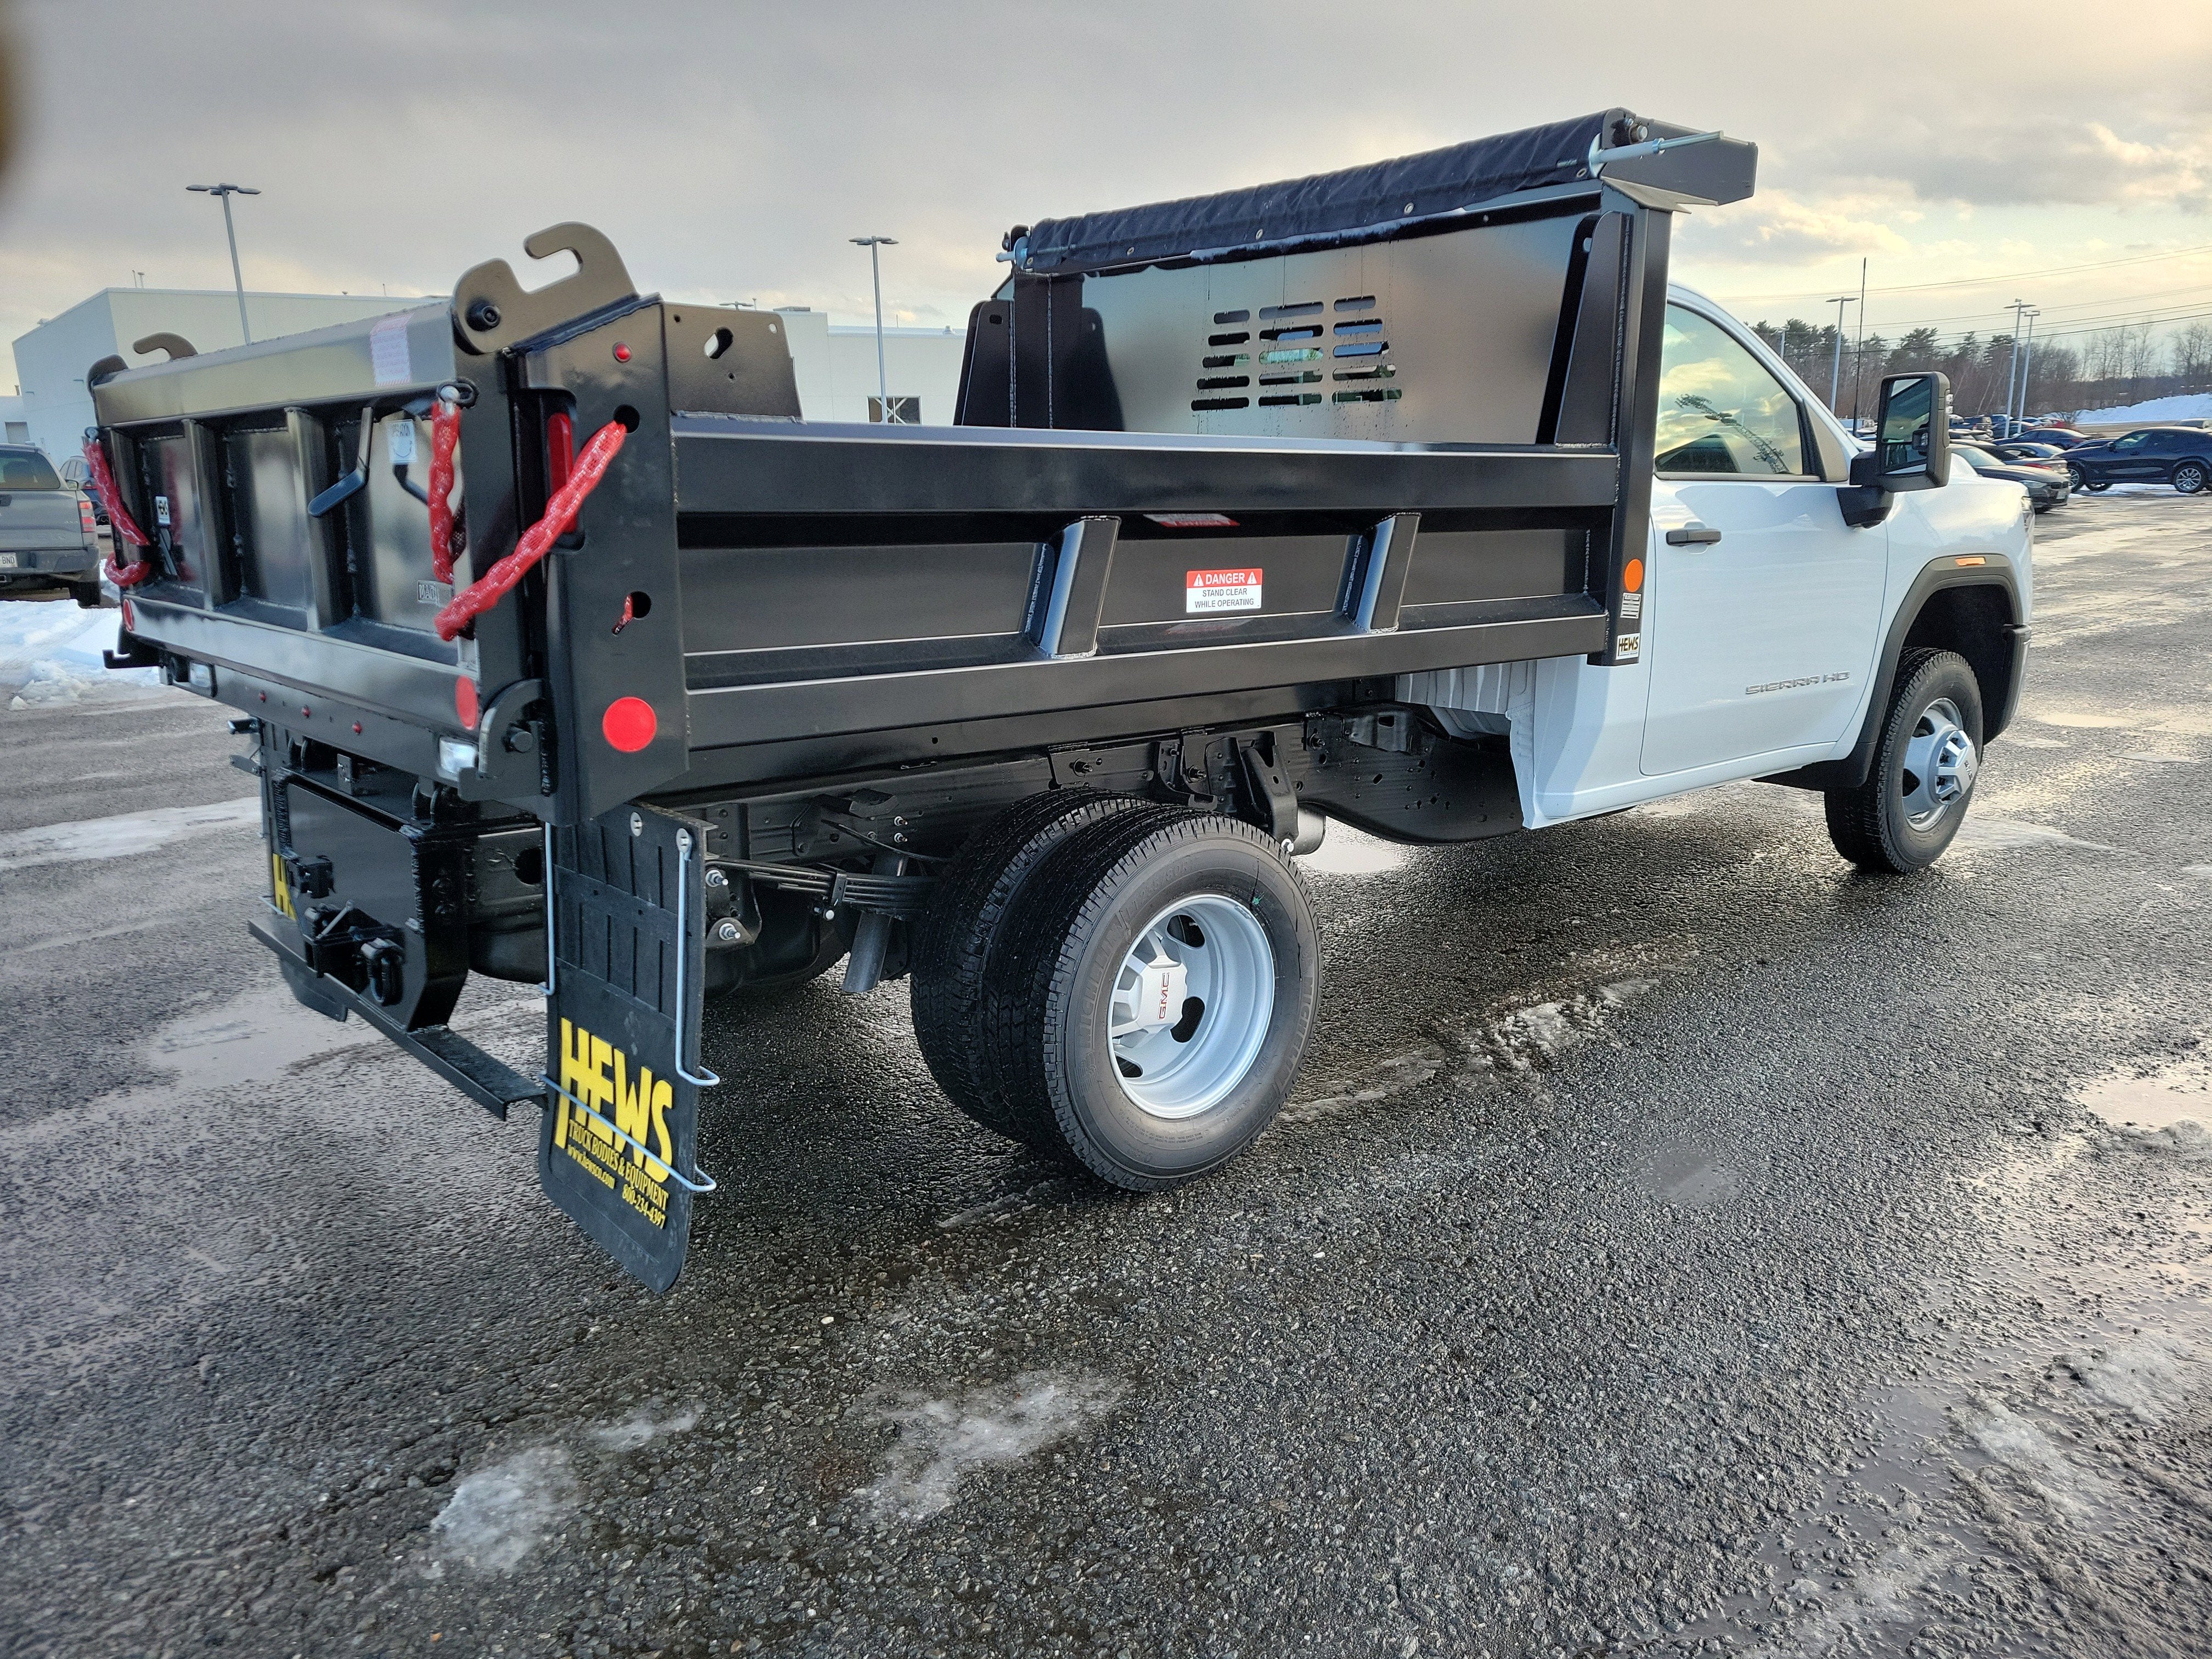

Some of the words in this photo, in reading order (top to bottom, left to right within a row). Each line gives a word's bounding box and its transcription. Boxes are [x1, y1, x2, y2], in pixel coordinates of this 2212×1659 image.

[1205, 572, 1245, 585] DANGER
[1195, 600, 1216, 608] WHILE
[1217, 598, 1254, 607] OPERATING
[1202, 589, 1224, 597] STAND
[1226, 588, 1248, 596] CLEAR
[1618, 636, 1639, 657] HEWS
[1745, 674, 1820, 695] SIERRA
[1822, 670, 1850, 683] HD
[1158, 972, 1170, 1020] GMC
[554, 1017, 673, 1183] HEWS
[569, 1119, 594, 1151] TRUCK
[592, 1136, 619, 1171] BODIES
[618, 1156, 625, 1177] &
[625, 1161, 669, 1211] EQUIPMENT
